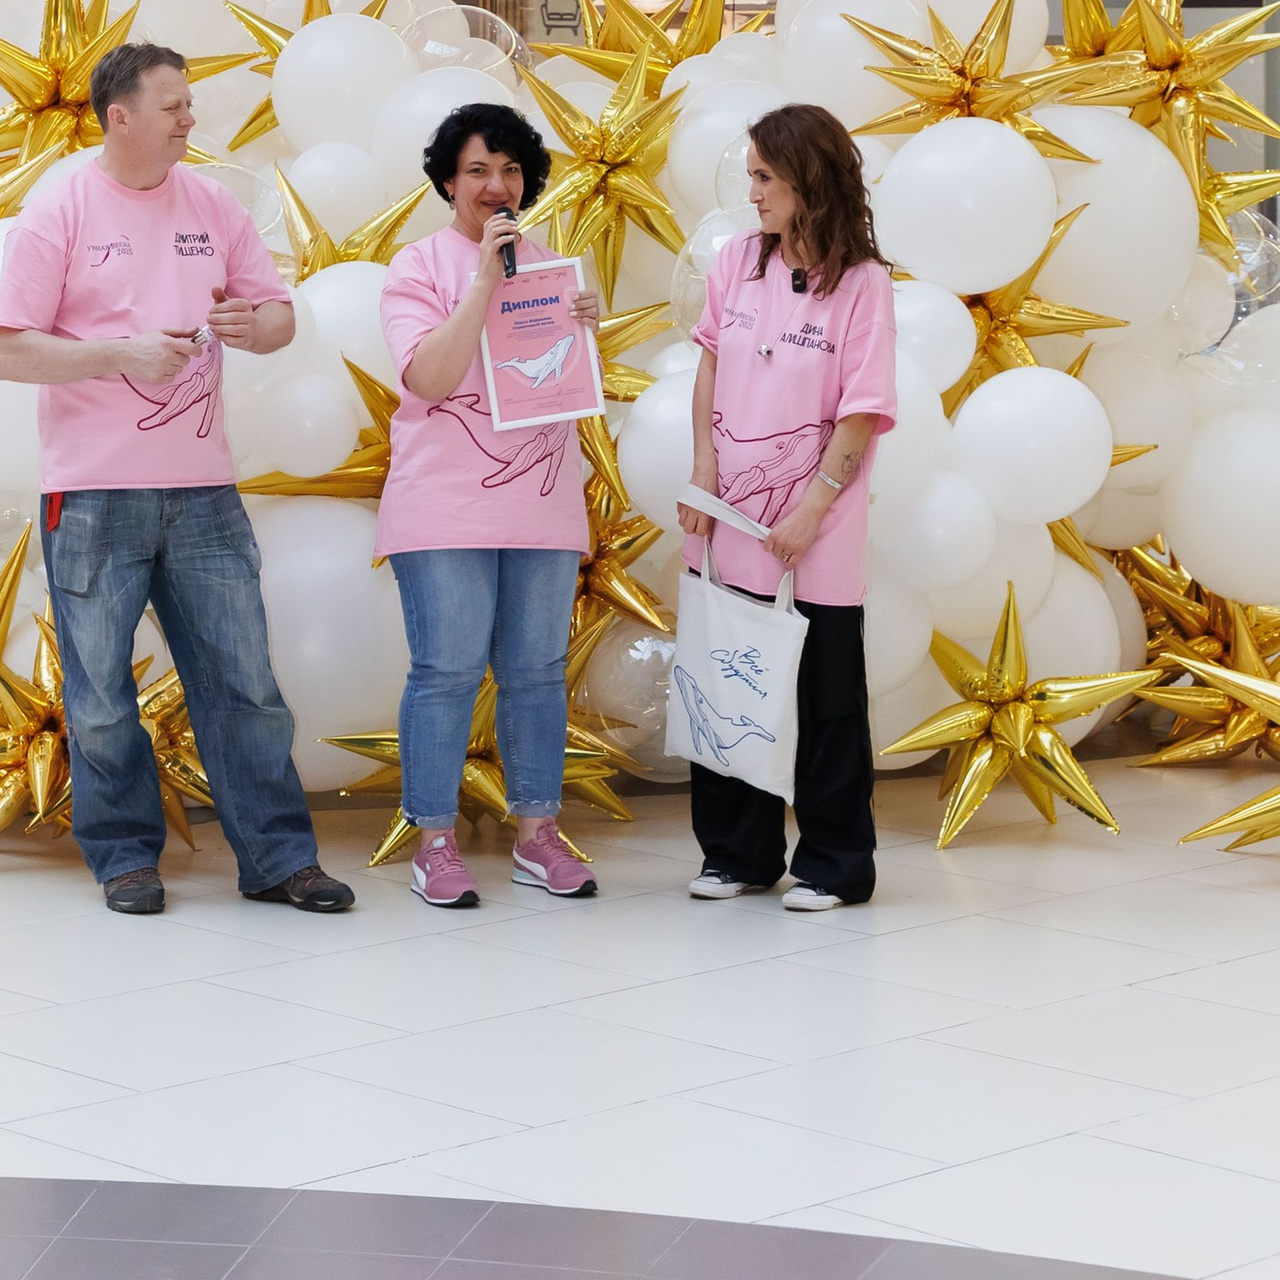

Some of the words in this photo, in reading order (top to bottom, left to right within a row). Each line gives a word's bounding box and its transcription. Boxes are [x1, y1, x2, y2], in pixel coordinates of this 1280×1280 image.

[175, 232, 210, 244] ДМИТРИЙ
[116, 248, 133, 256] 2025
[173, 245, 215, 257] ТИЩЕНКО
[500, 296, 560, 314] Диплом
[800, 322, 824, 336] ДИНА
